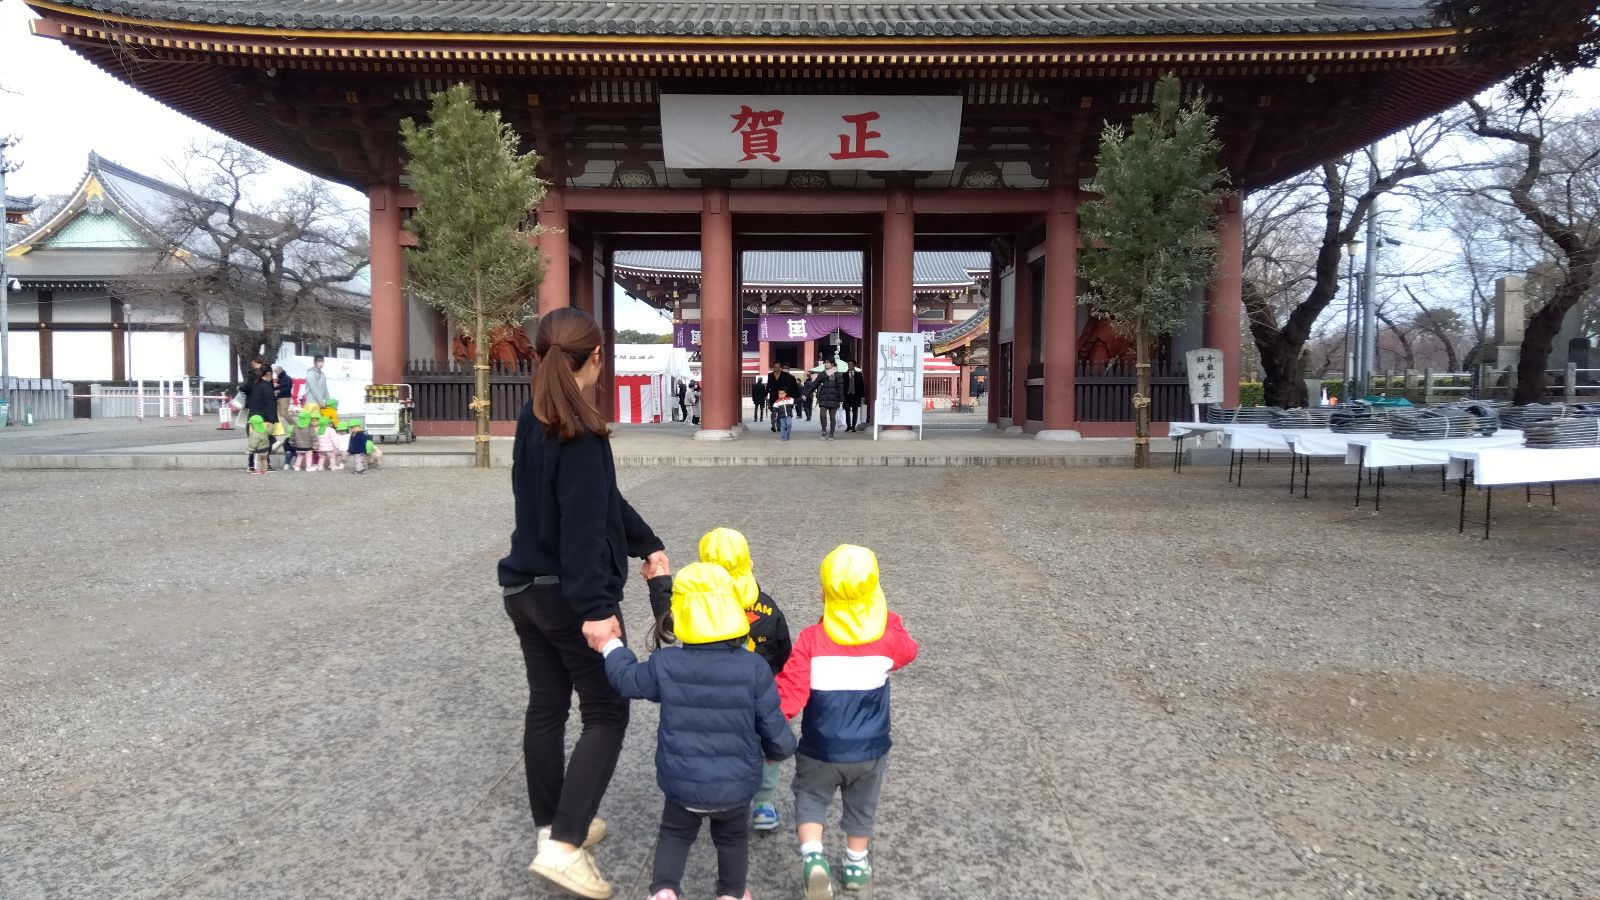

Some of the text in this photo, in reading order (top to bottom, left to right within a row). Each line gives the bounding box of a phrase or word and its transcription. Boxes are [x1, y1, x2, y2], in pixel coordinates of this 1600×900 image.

[730, 105, 890, 163] 賀正
[890, 335, 912, 343] ご案内
